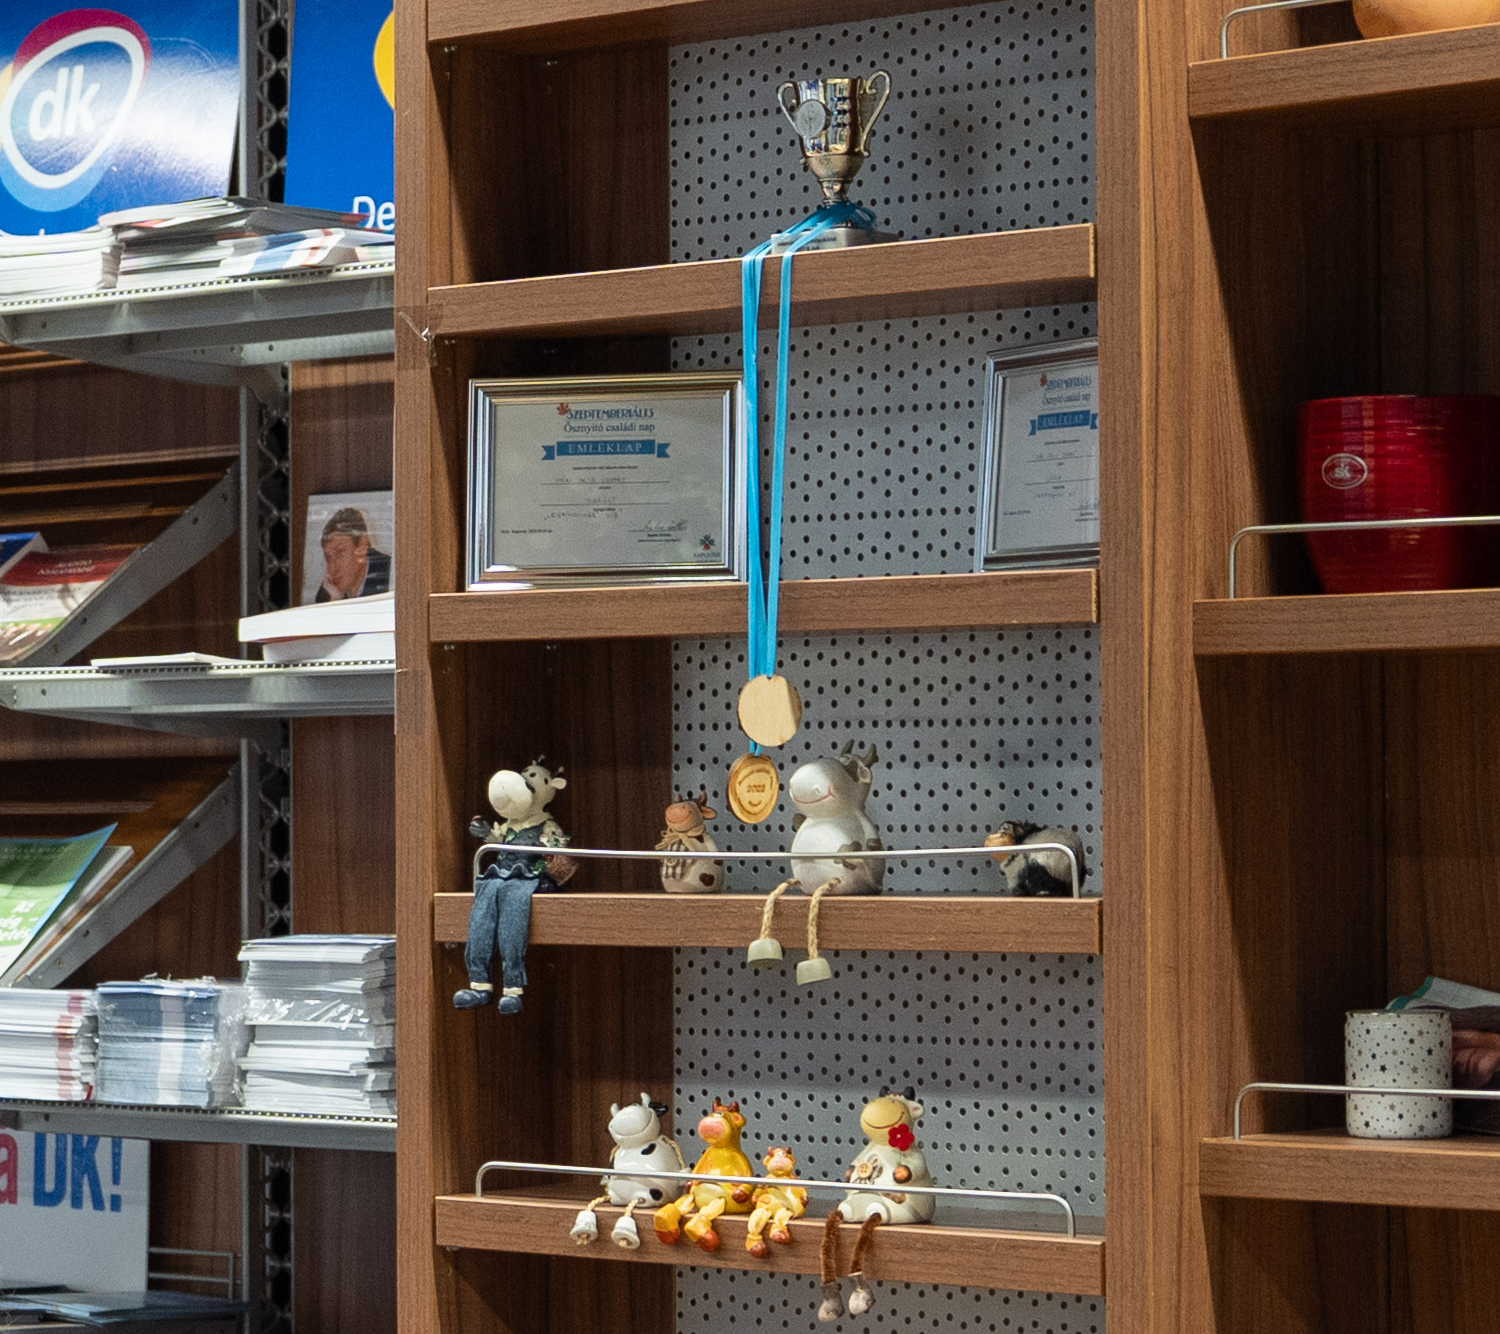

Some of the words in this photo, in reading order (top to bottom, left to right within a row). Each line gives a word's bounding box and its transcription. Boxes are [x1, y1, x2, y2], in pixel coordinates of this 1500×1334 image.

[27, 67, 102, 142] dk
[564, 421, 604, 434] Ősznyitó
[606, 422, 637, 432] családi
[639, 423, 655, 434] nap
[568, 440, 643, 454] EMLÉKLAP
[33, 1132, 124, 1212] DK!
